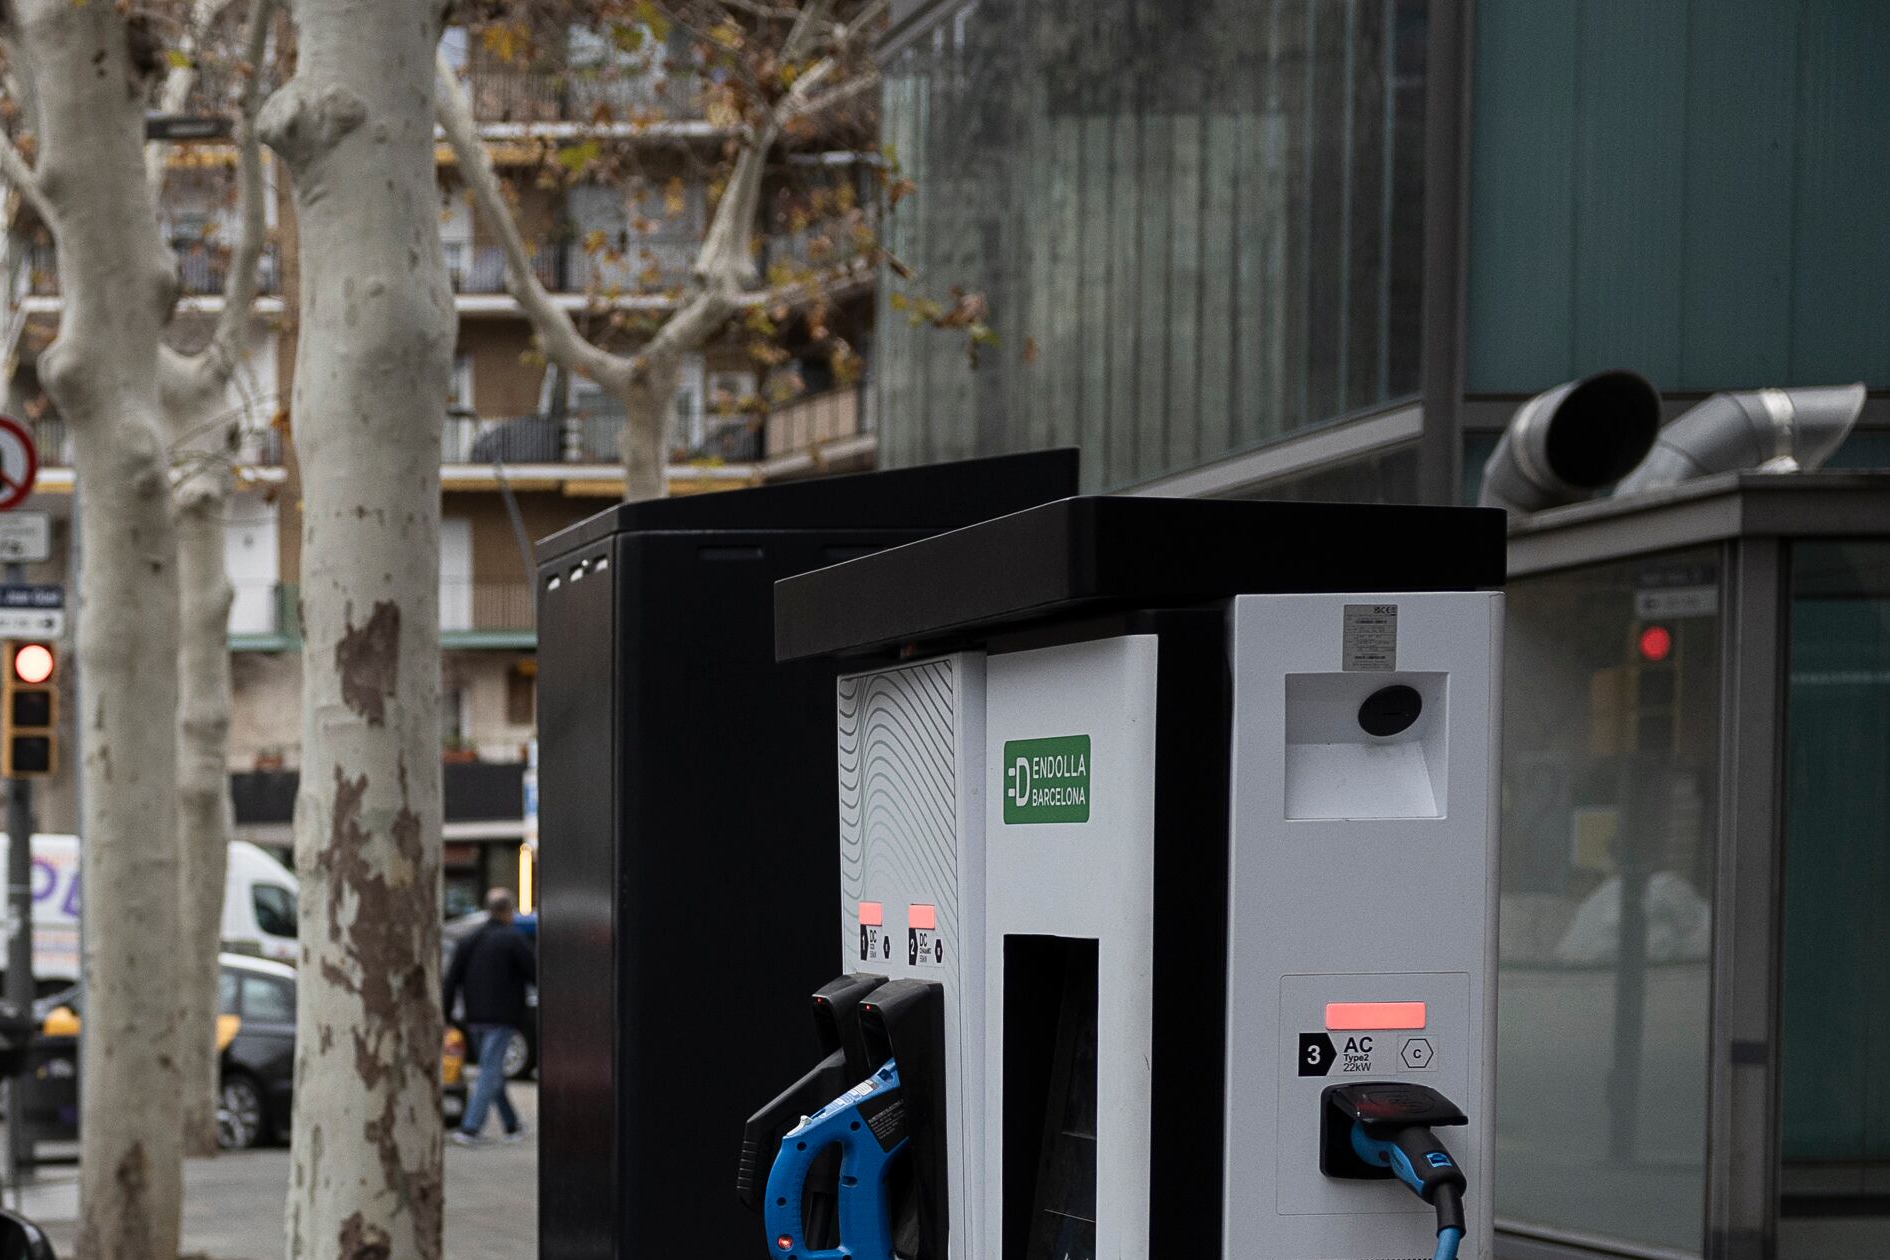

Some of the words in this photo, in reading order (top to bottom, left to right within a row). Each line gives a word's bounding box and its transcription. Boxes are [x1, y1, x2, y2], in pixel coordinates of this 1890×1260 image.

[1032, 753, 1086, 779] ENDOLLA
[1032, 787, 1086, 806] BARCELONA
[870, 929, 877, 943] DC
[919, 933, 927, 946] DC
[910, 939, 915, 955] 2
[1344, 1036, 1373, 1053] AC
[1307, 1044, 1321, 1065] 3
[1343, 1053, 1369, 1063] Type2
[1413, 1049, 1422, 1059] C
[1343, 1062, 1372, 1072] 22kW
